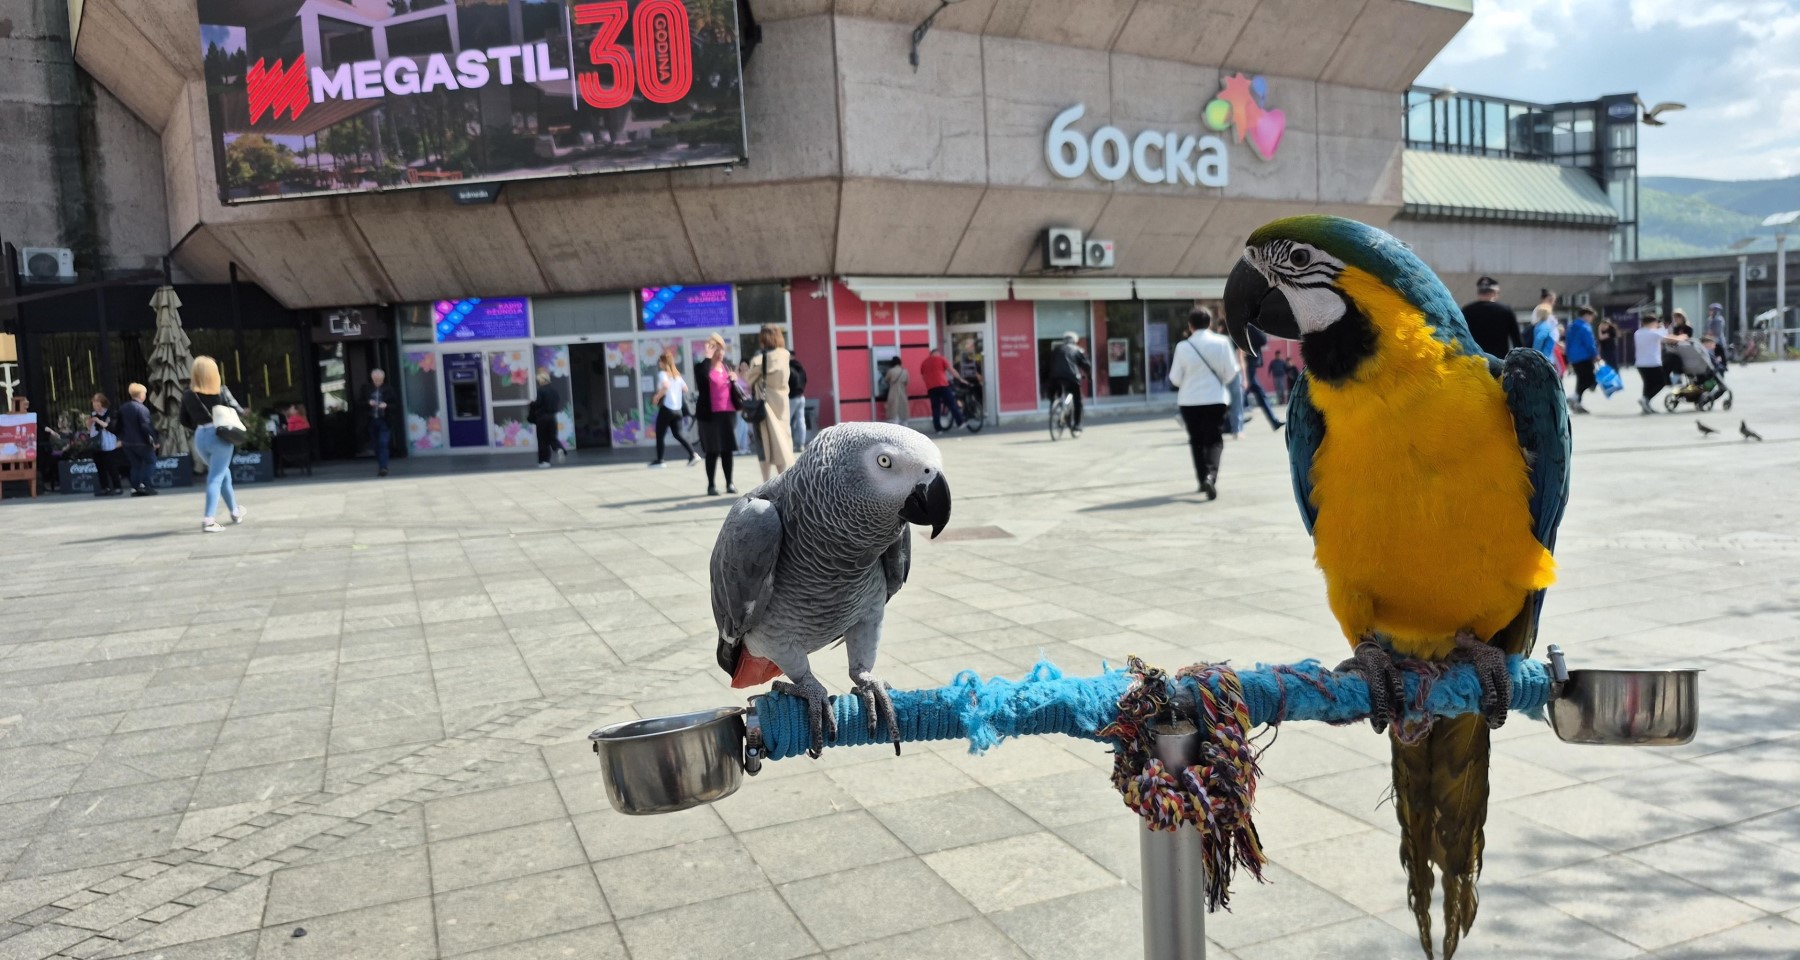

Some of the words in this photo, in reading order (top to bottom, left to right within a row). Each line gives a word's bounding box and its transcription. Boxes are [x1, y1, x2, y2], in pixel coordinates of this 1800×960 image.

[311, 43, 569, 103] MEGASTIL
[574, 0, 692, 109] 30
[654, 17, 671, 81] GODINA
[1046, 102, 1229, 187] боска
